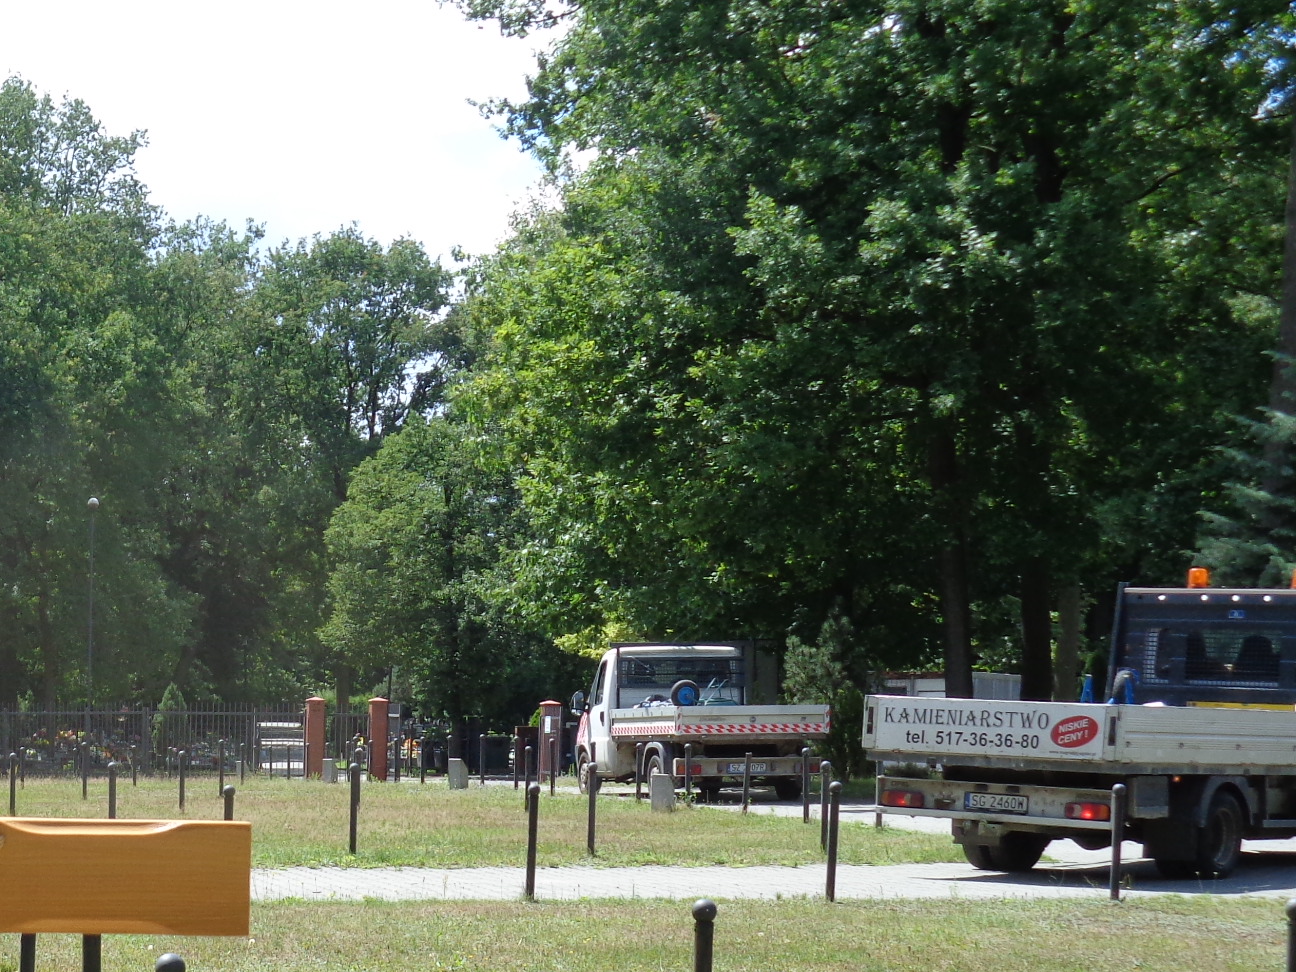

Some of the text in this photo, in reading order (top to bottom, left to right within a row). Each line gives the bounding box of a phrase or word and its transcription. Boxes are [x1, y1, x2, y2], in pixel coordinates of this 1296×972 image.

[884, 706, 1050, 730] KAMIENIARSTWO
[1058, 718, 1089, 734] NISKIE
[906, 729, 1040, 749] tel. 517-36-36-80
[1057, 730, 1084, 744] CENY
[972, 794, 985, 807] SG
